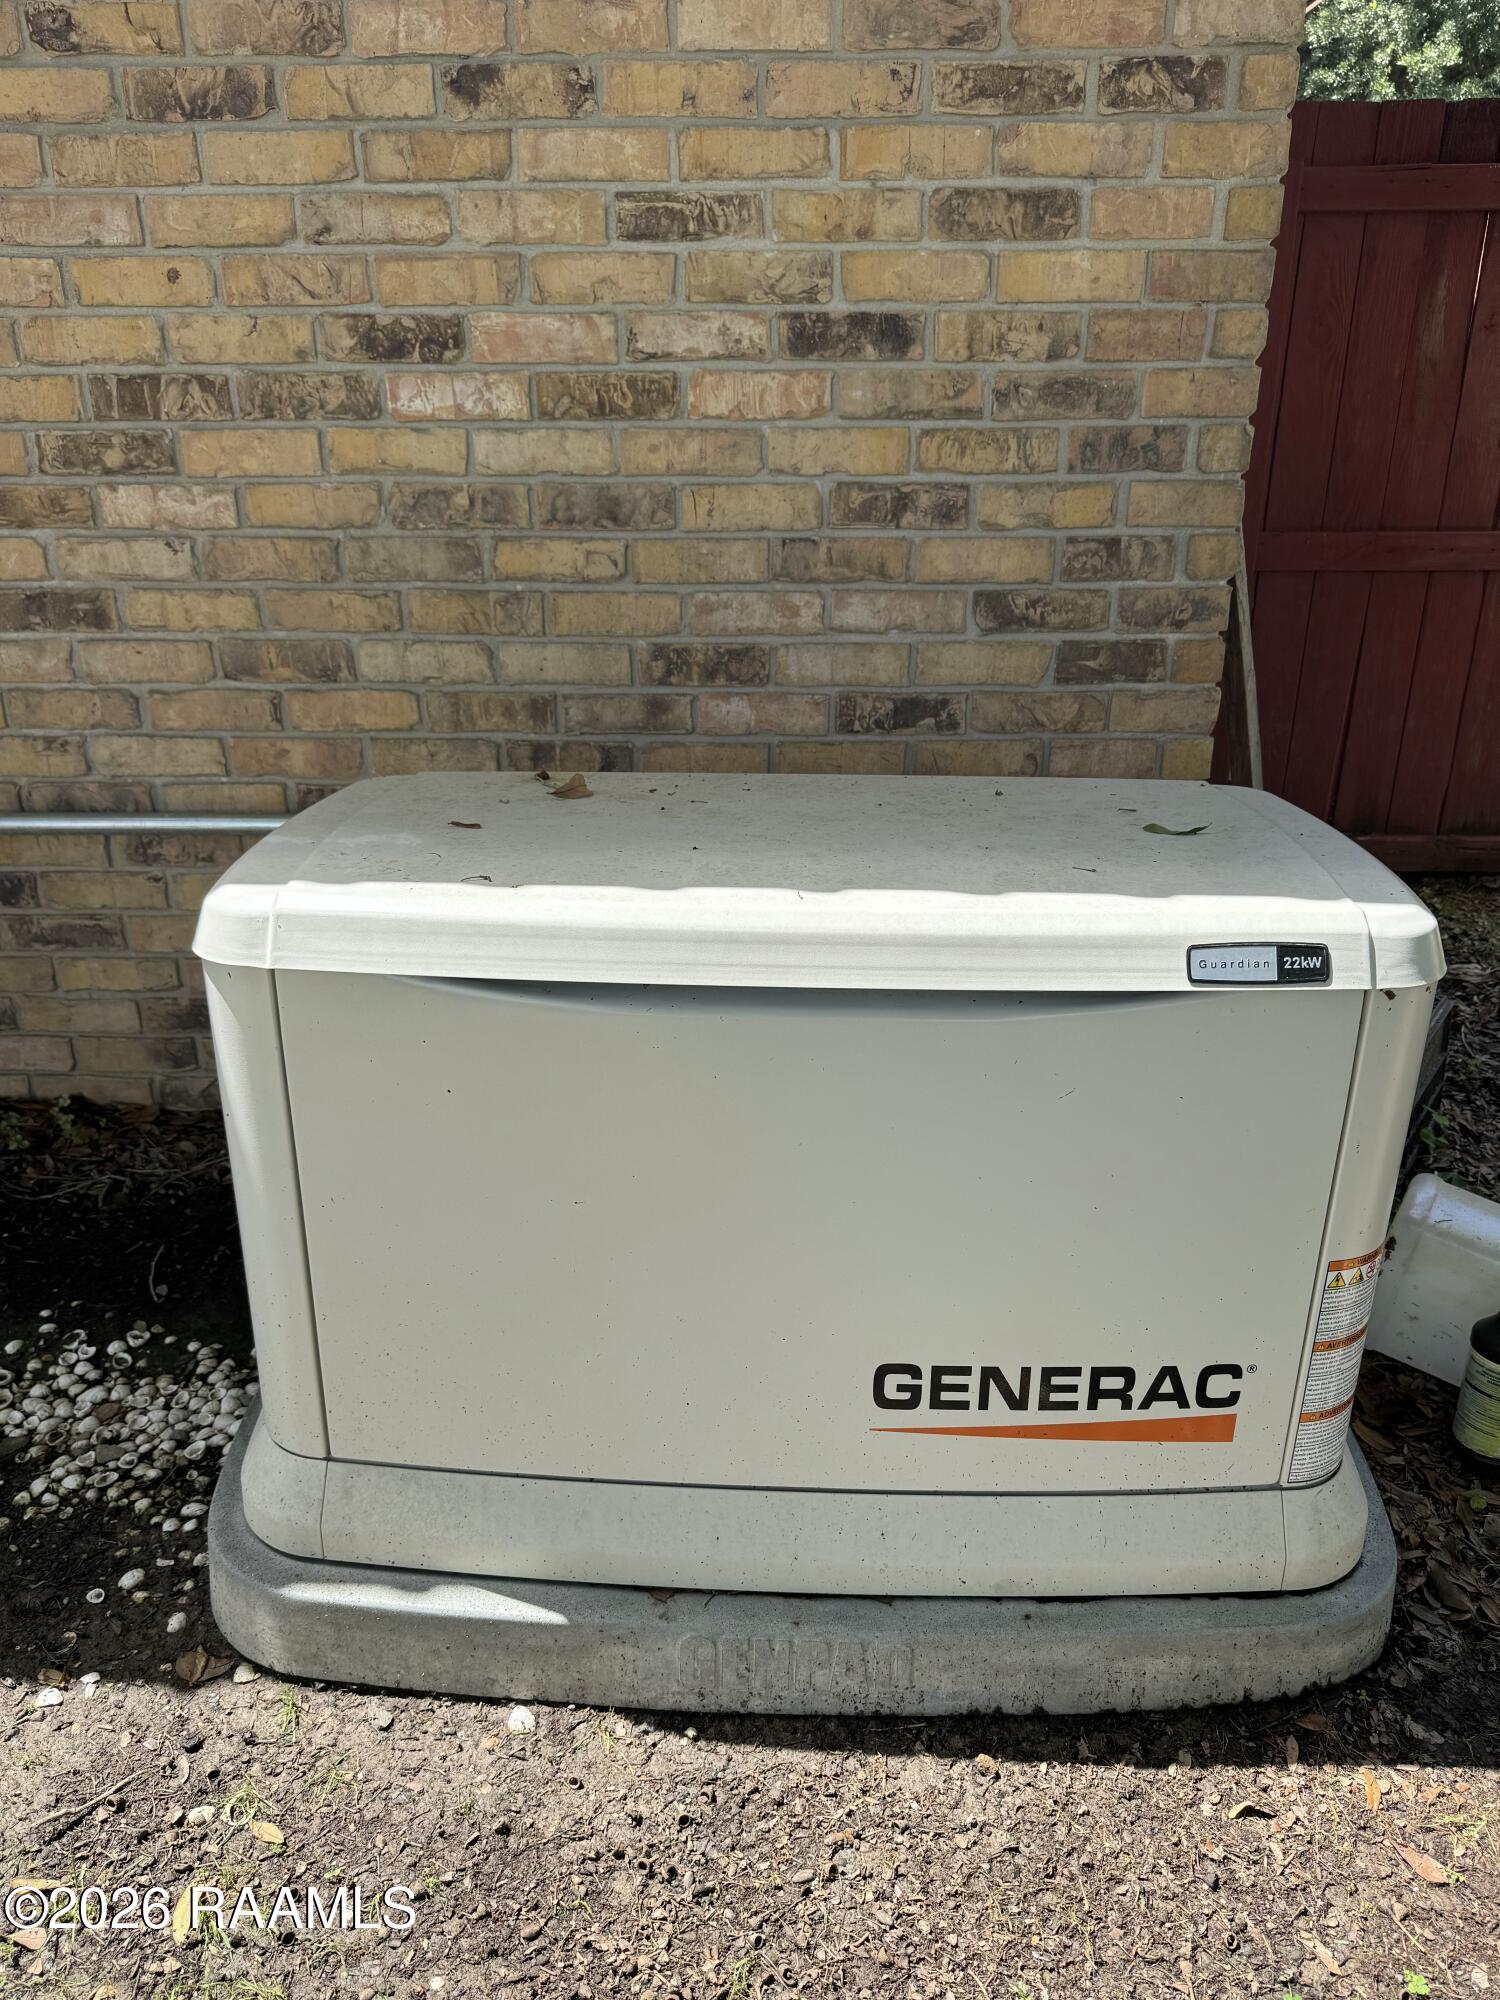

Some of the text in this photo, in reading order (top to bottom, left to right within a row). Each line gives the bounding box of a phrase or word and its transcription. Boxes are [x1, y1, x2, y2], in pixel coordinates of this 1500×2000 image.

[1198, 956, 1322, 969] Guardian 22kW
[873, 1363, 1243, 1411] GENERAC
